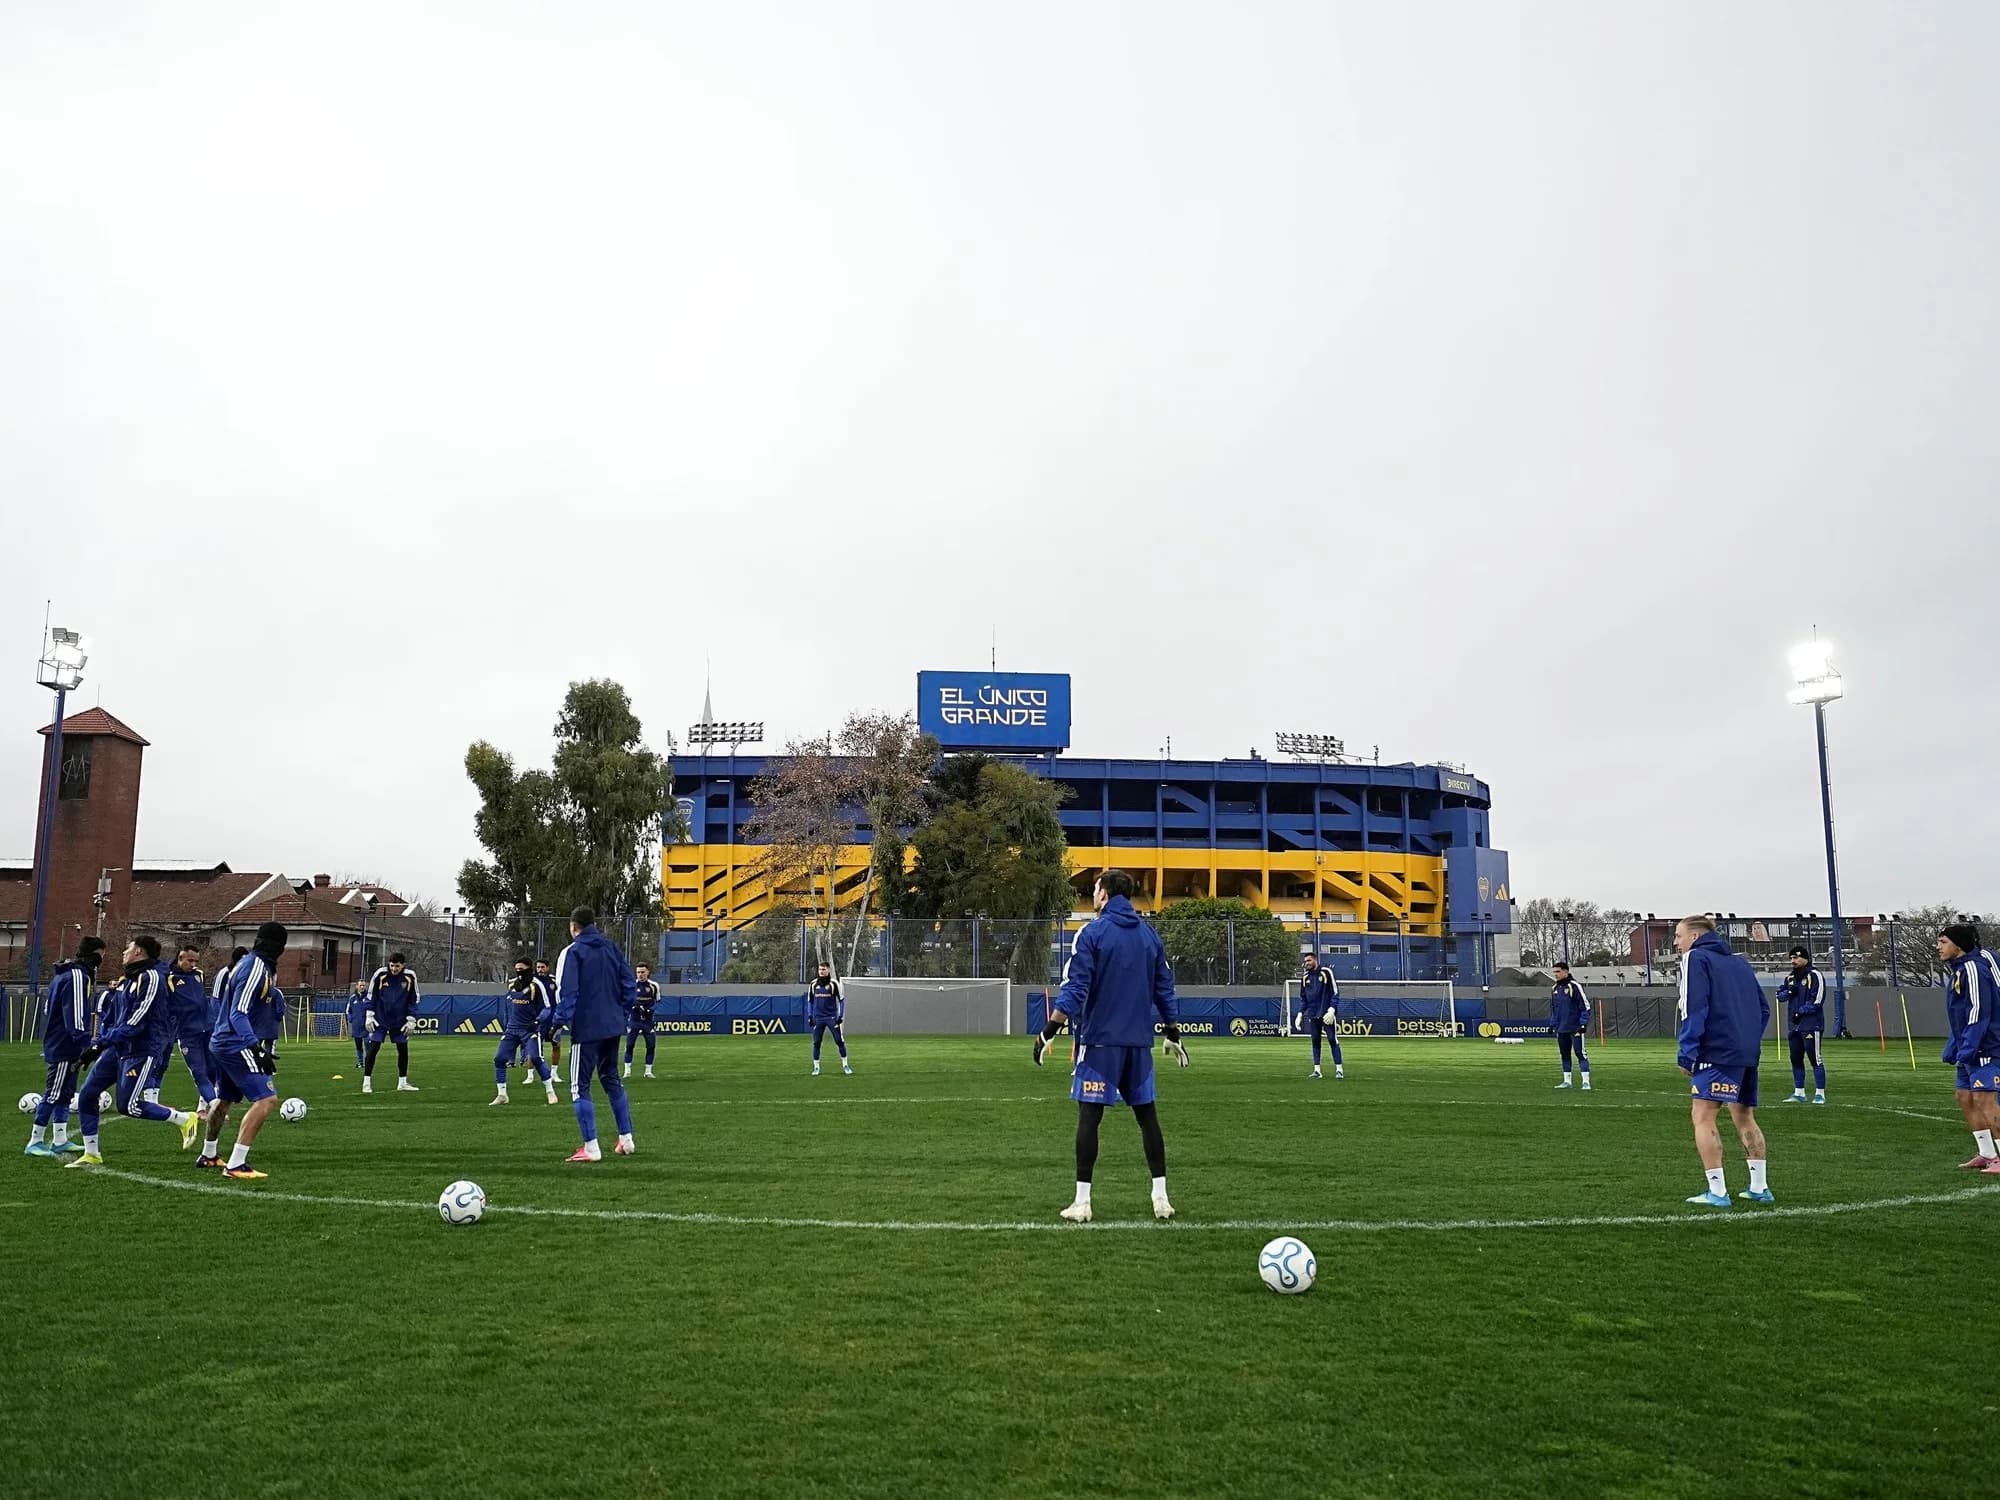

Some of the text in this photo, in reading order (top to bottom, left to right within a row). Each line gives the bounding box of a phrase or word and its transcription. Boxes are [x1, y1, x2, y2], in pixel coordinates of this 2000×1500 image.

[940, 685, 1047, 706] EL ÚNICO
[941, 707, 1047, 726] GRANDE
[653, 1021, 712, 1032] ATORADE
[732, 1017, 786, 1035] BBVA
[1321, 1019, 1373, 1036] abify
[1504, 1025, 1555, 1033] mastercar
[1083, 1081, 1106, 1093] pax
[1711, 1082, 1738, 1094] pax
